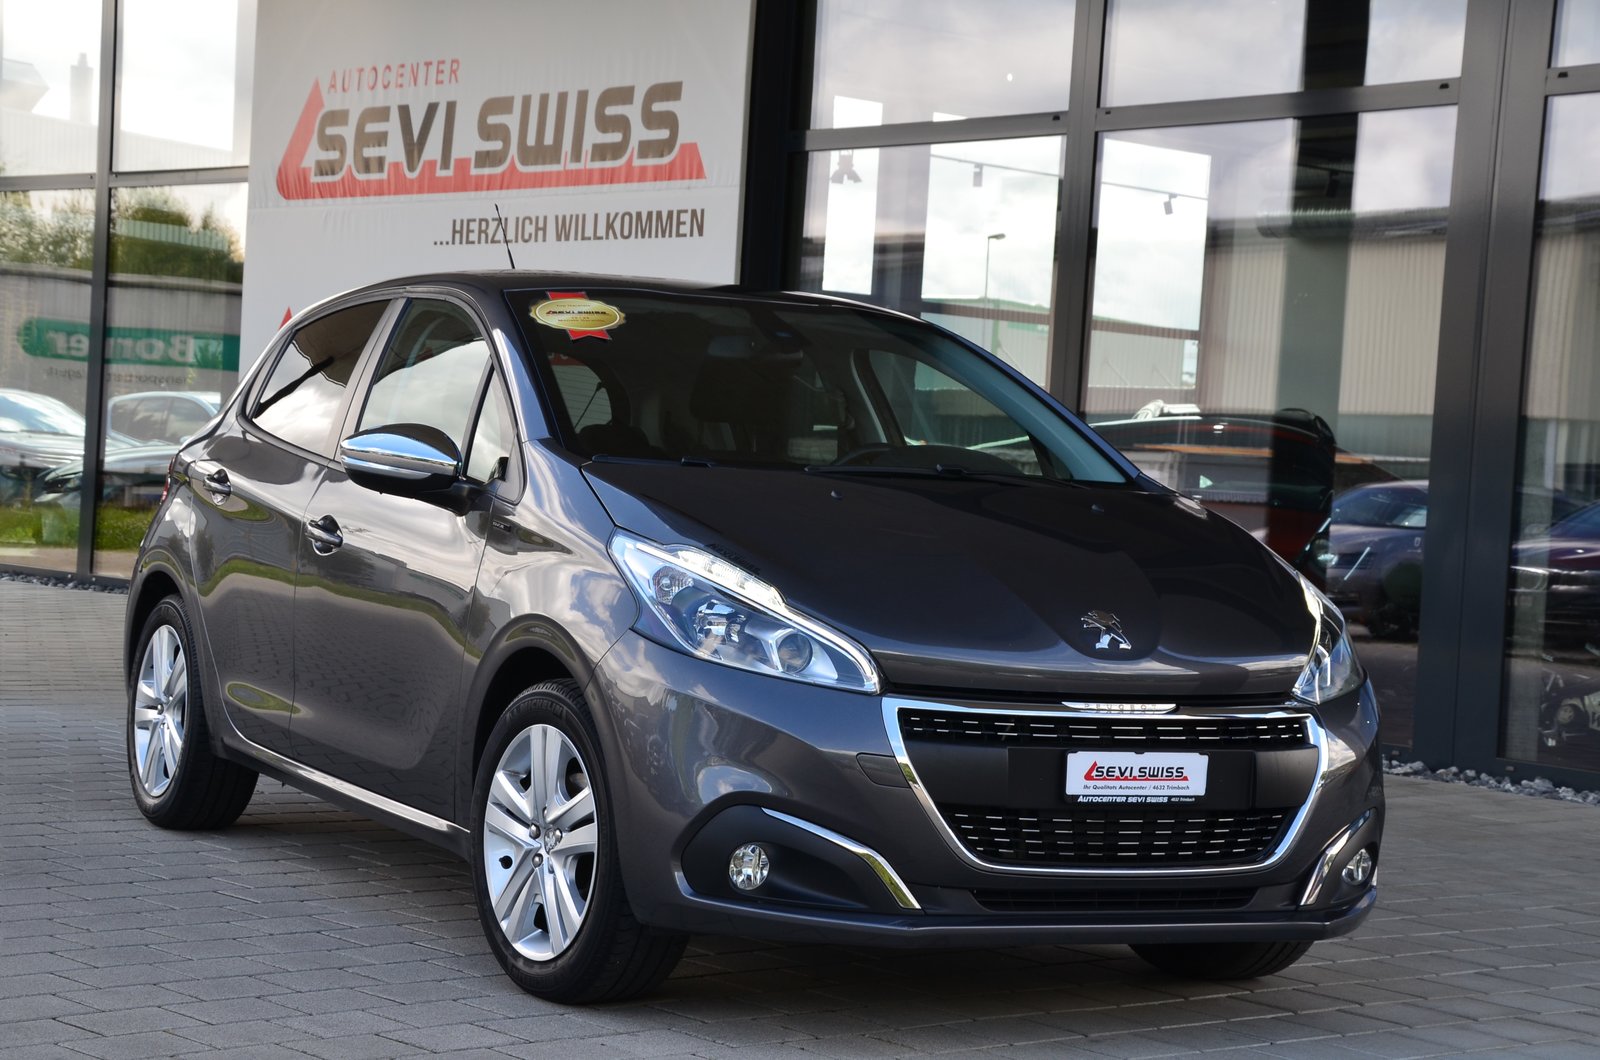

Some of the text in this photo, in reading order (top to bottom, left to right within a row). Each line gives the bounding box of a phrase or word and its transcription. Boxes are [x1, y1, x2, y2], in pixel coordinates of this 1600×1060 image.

[327, 58, 462, 95] AUTOCENTER
[313, 80, 684, 177] SEVI SWISS
[554, 208, 705, 242] WILLKOMMEN
[1084, 703, 1157, 711] PEUGEOT
[1095, 766, 1185, 778] SEVI SWISS
